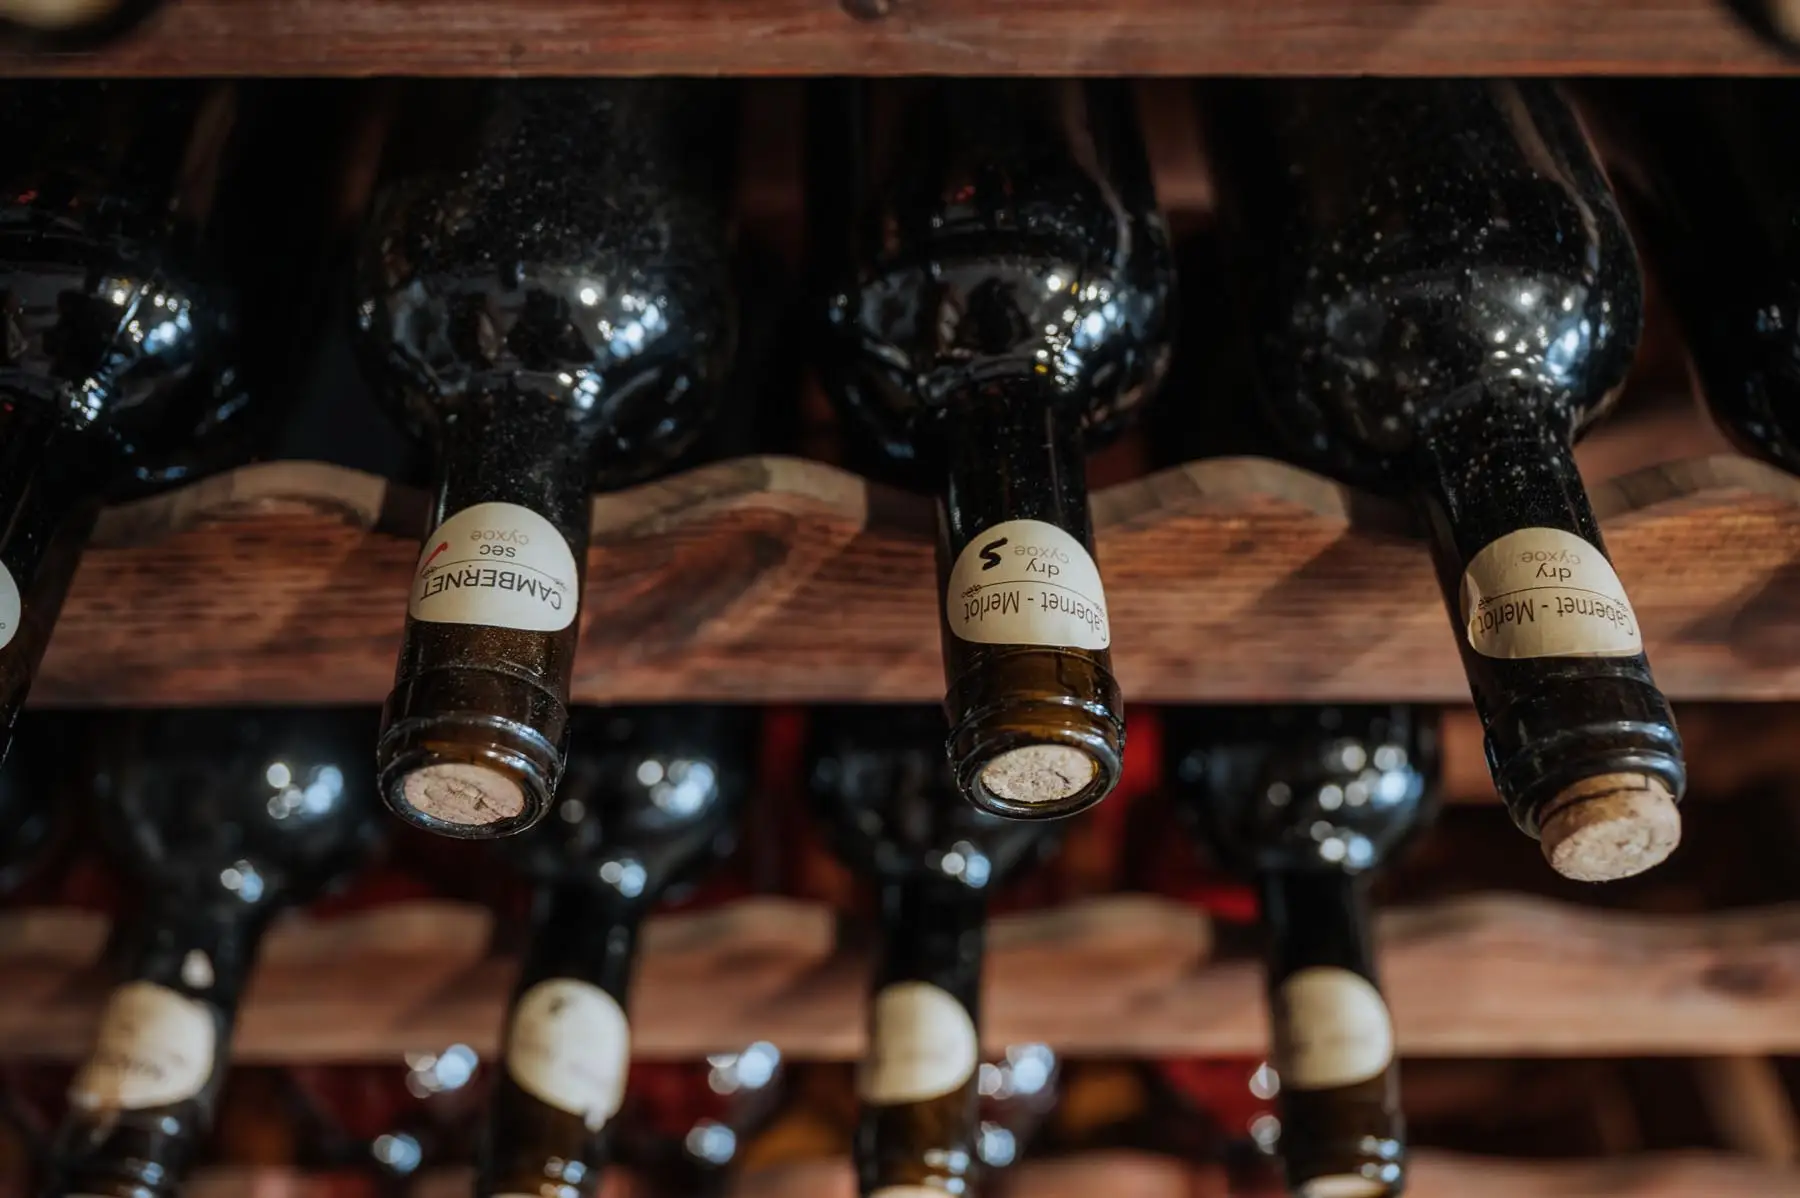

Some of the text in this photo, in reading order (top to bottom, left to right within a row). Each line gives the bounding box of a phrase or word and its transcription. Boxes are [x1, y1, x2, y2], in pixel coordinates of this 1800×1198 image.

[470, 529, 529, 546] сухое
[479, 544, 517, 558] sec
[1014, 546, 1069, 565] сухое
[1521, 549, 1581, 565] сухое
[1026, 558, 1059, 578] dry
[1536, 563, 1571, 582] dry
[419, 568, 562, 610] CAMBERNET
[964, 591, 1020, 623] Merlot
[1041, 592, 1107, 642] Cabernet
[1555, 596, 1634, 636] Cabernet
[1478, 598, 1535, 637] Merlot
